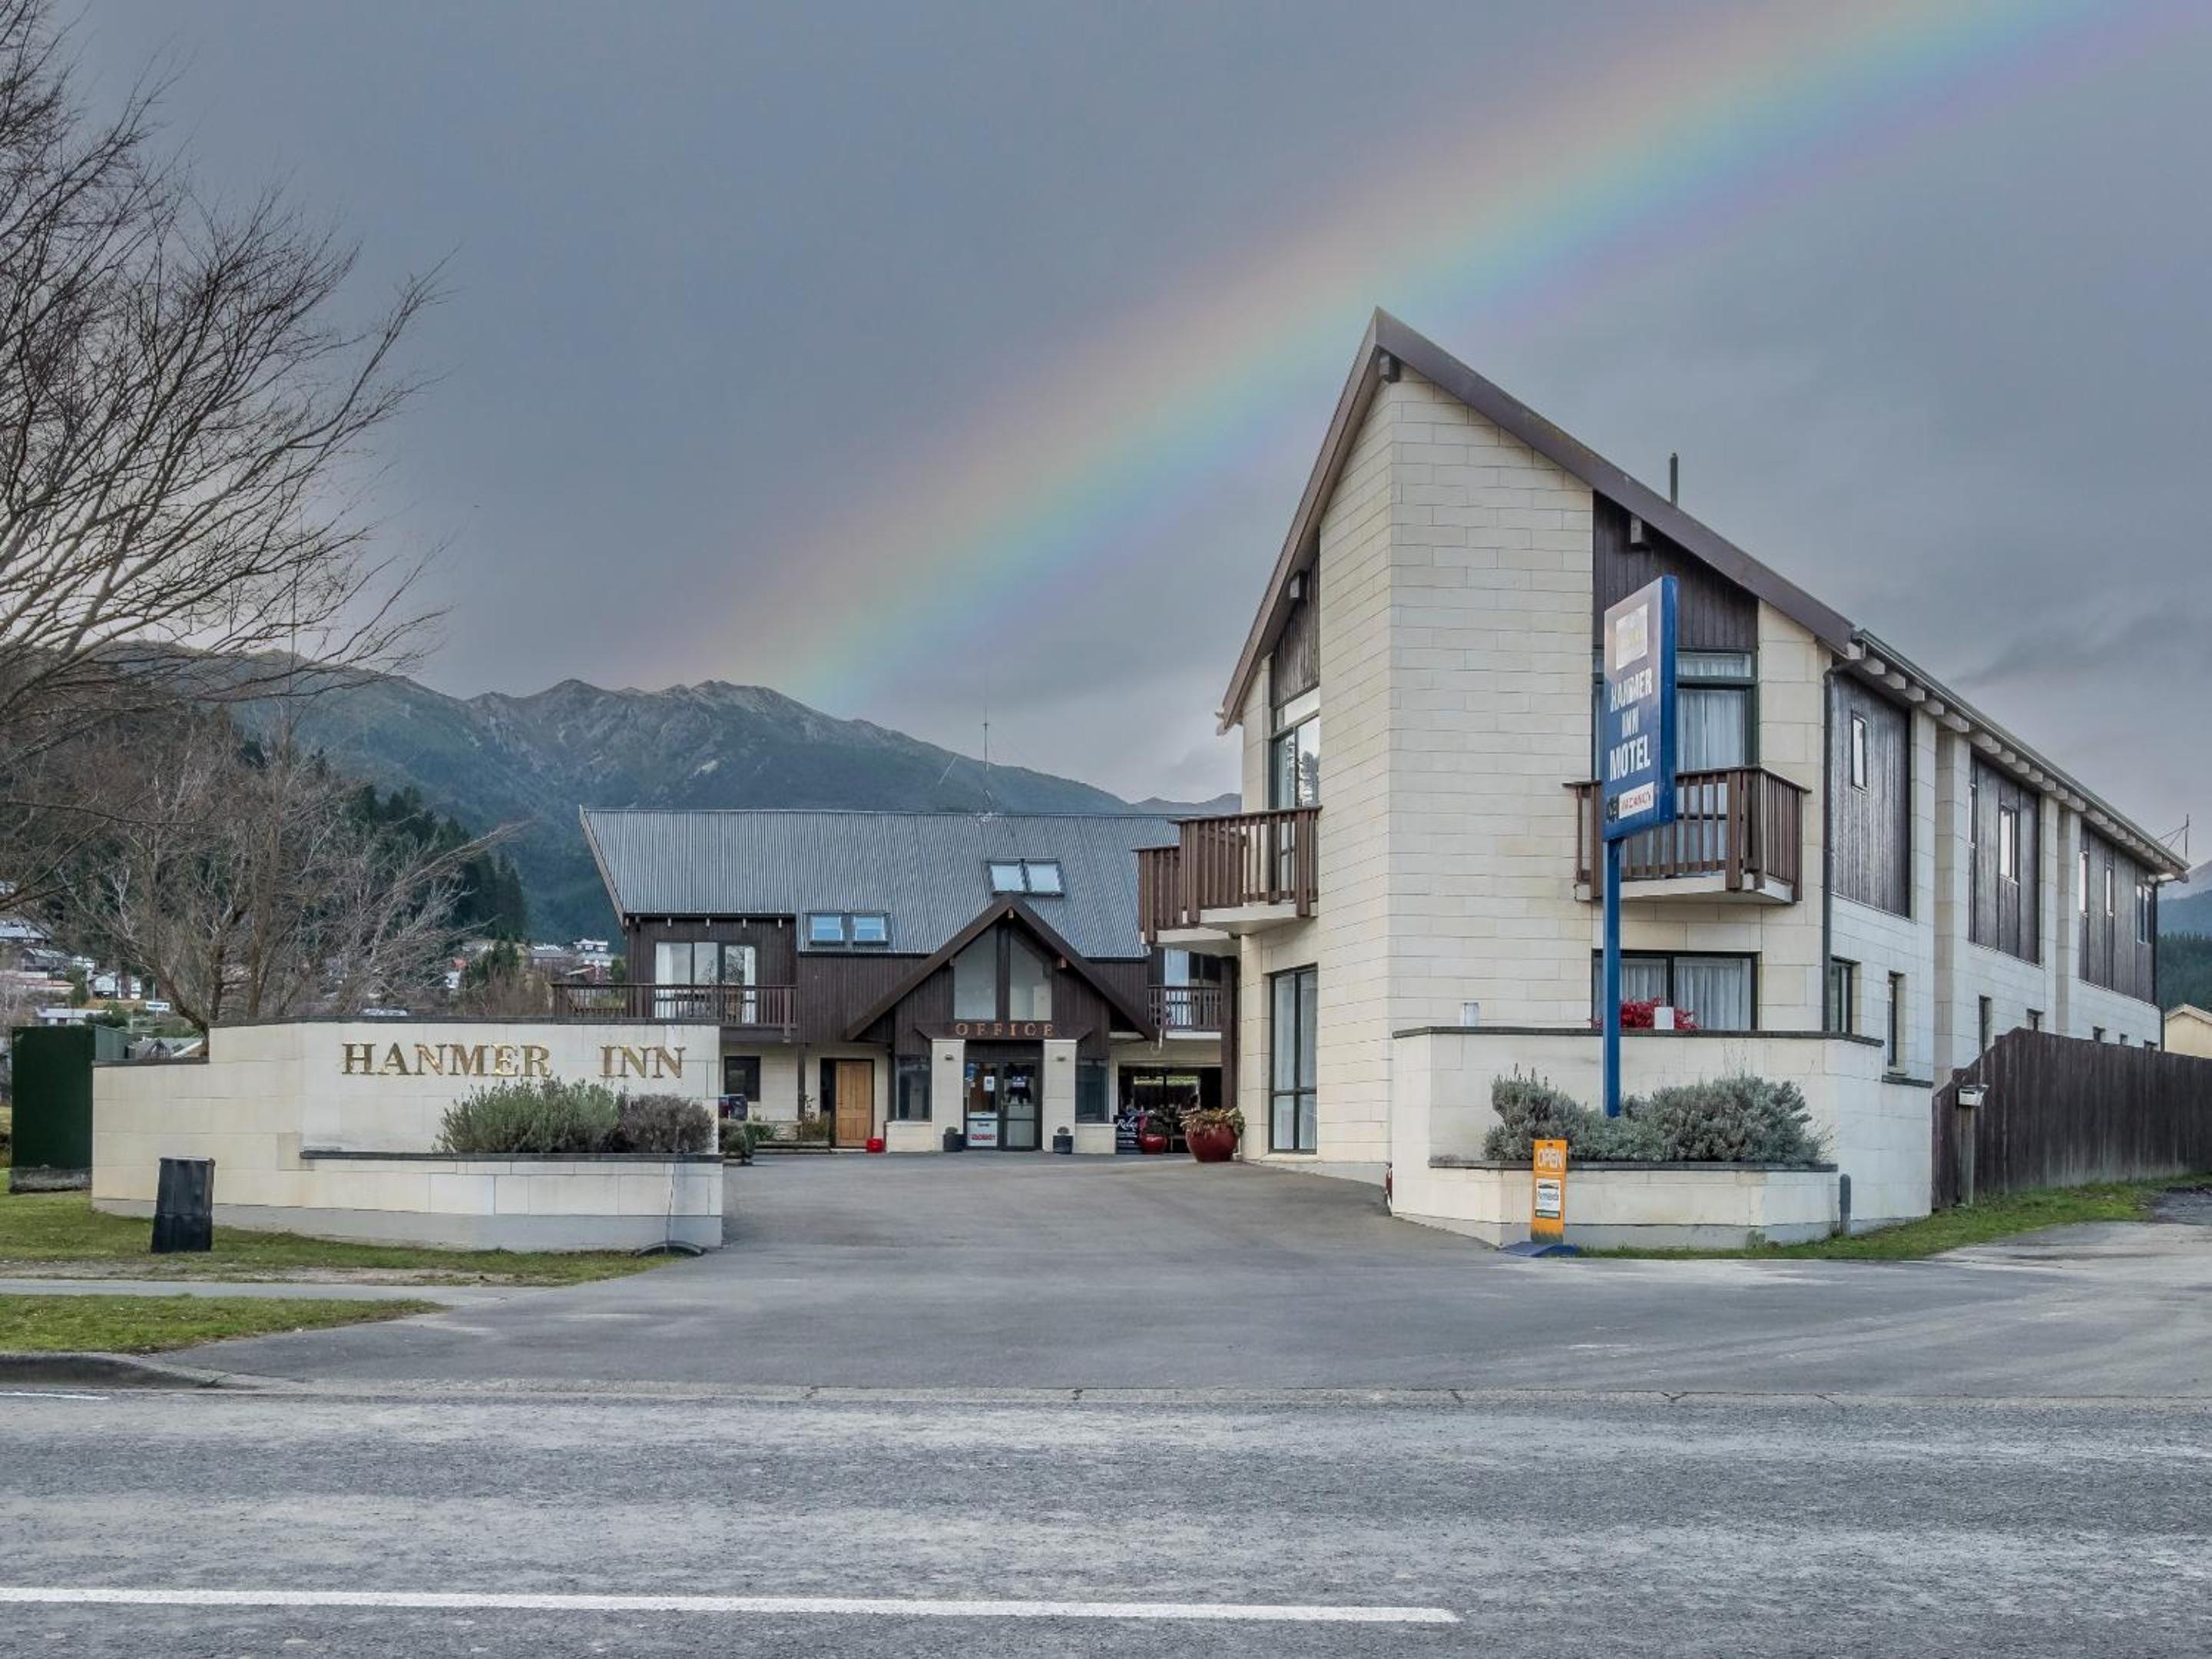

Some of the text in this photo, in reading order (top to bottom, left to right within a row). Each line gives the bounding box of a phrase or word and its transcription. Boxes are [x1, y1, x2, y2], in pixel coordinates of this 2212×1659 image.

[1611, 667, 1652, 713] HANMER
[1622, 707, 1639, 738] INN
[1610, 735, 1651, 782] MOTEL
[955, 1023, 1055, 1036] OFFICE
[341, 1042, 687, 1078] HANMER INN
[1538, 1148, 1562, 1168] OPEN
